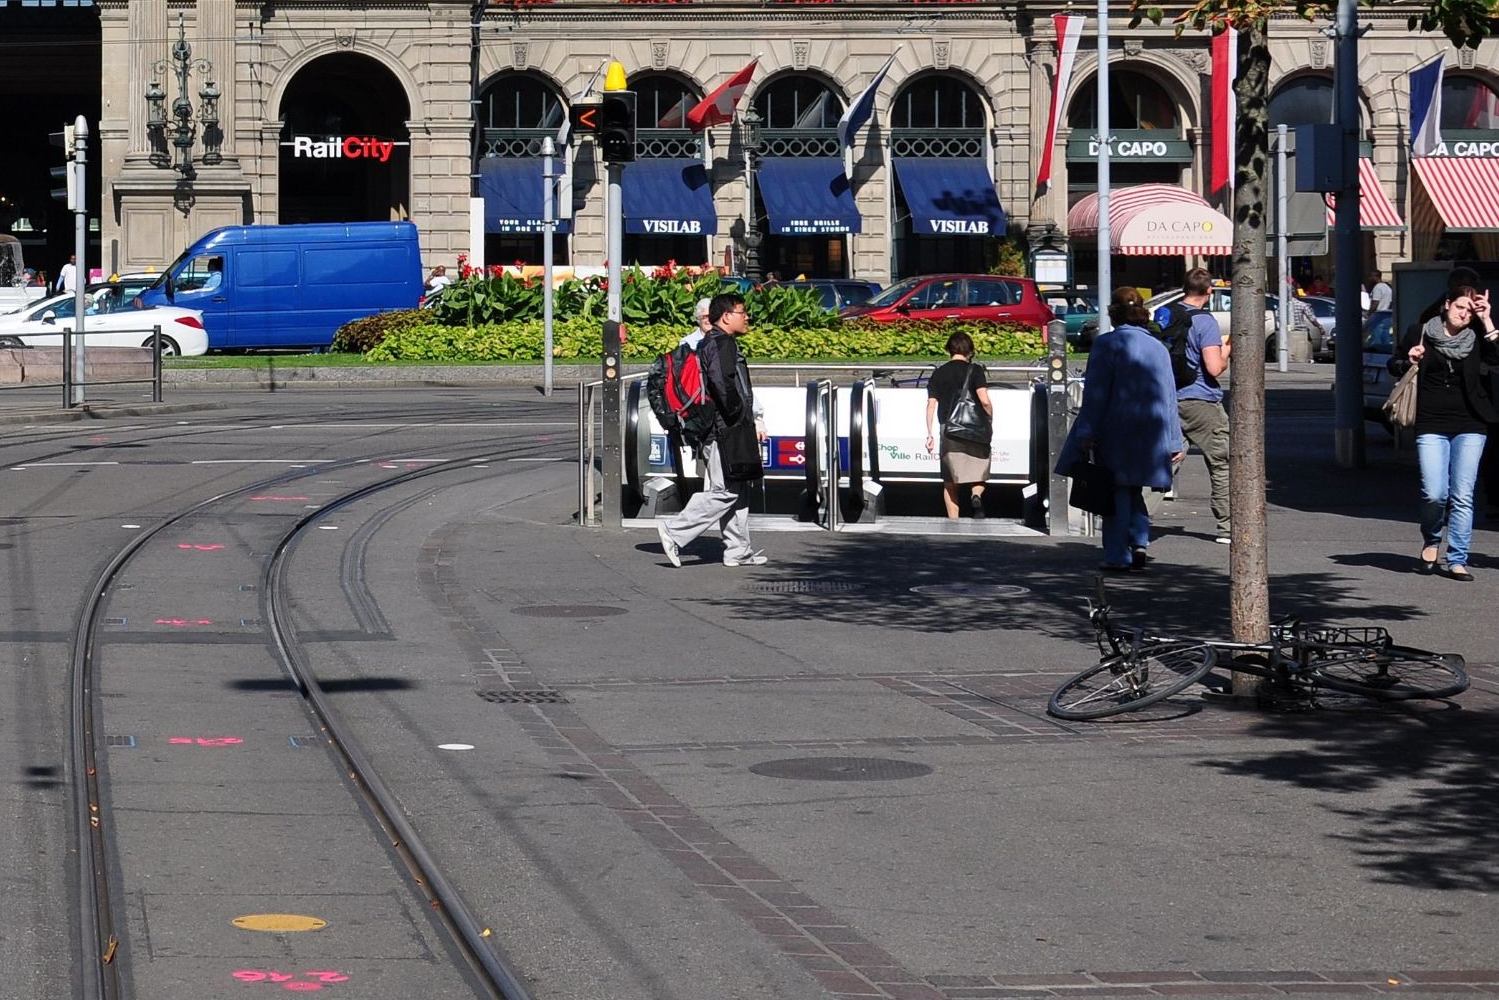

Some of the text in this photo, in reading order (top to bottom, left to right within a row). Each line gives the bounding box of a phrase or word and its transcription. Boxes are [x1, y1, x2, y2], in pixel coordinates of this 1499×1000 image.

[294, 136, 394, 162] RailCity
[1117, 141, 1167, 157] CAPO
[642, 219, 700, 233] VISILAB
[930, 219, 989, 234] VISILAB
[1147, 221, 1213, 232] DA CAPO
